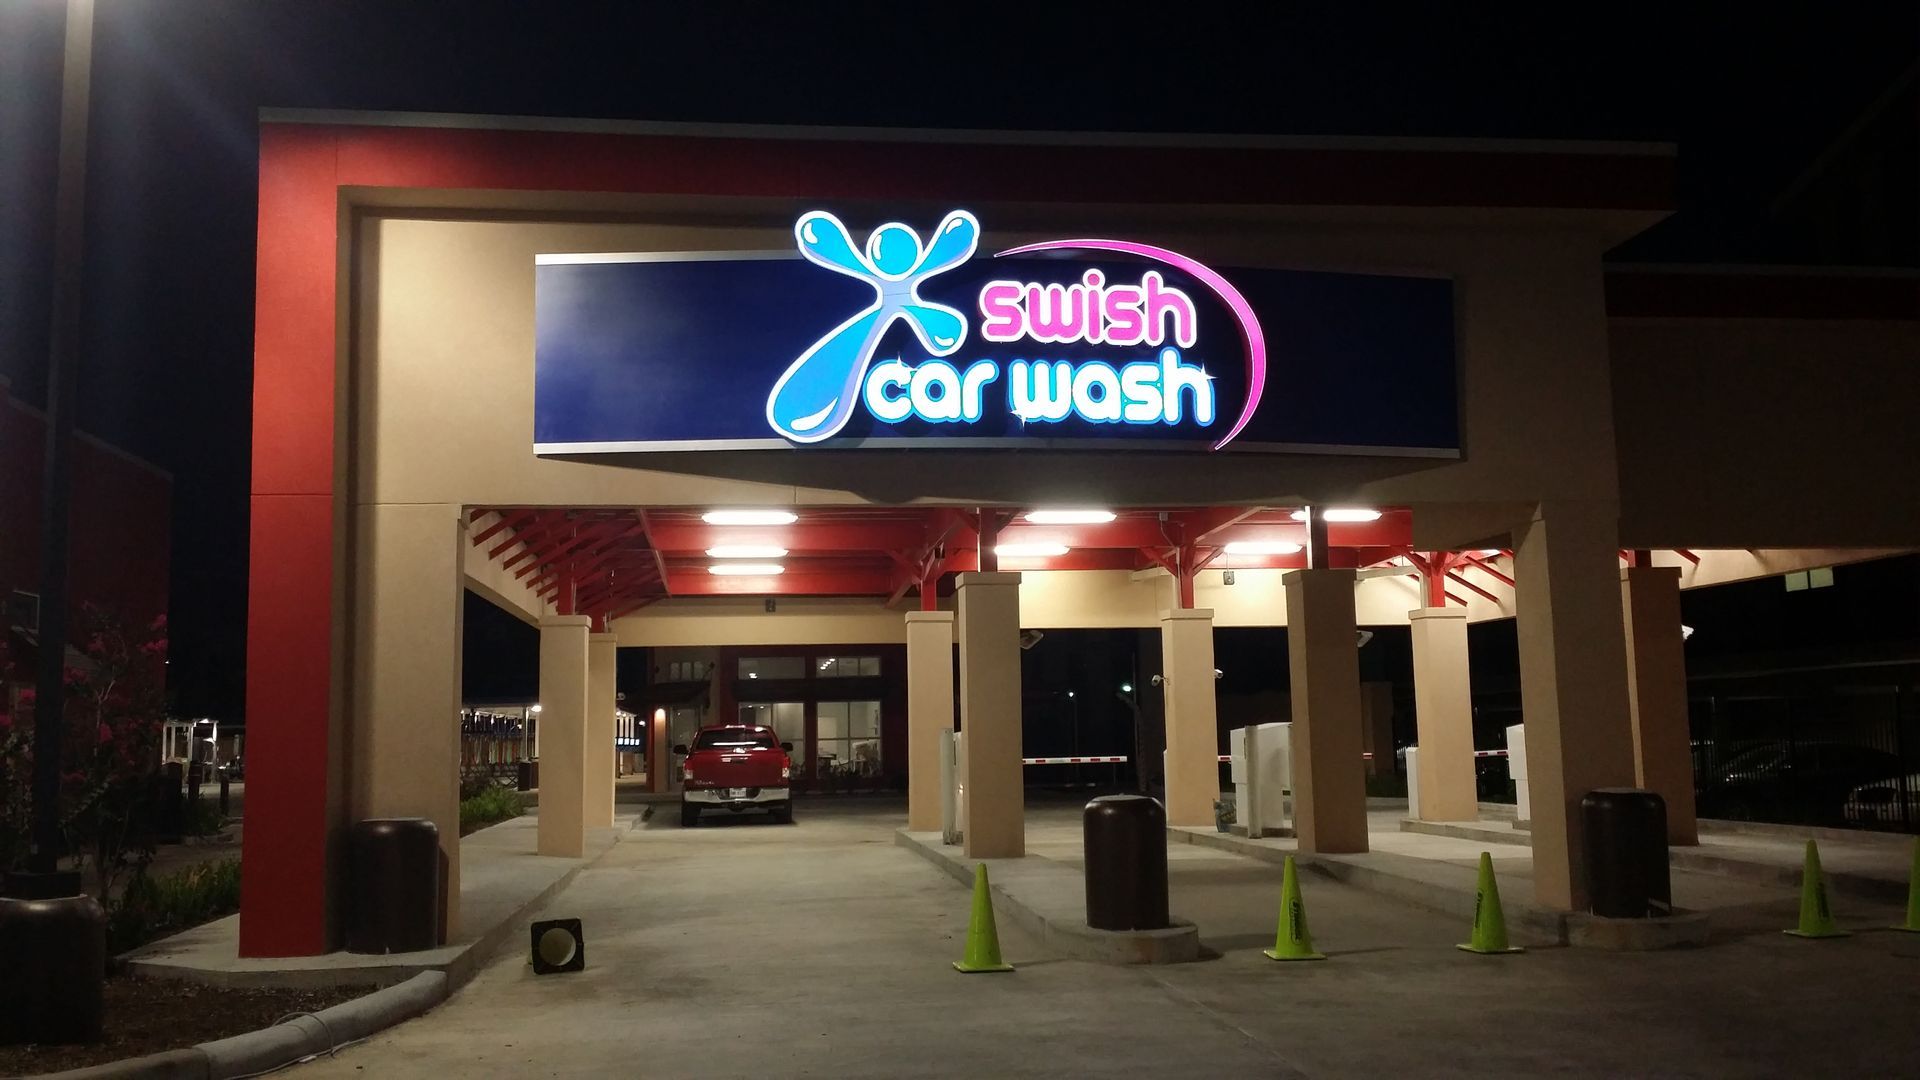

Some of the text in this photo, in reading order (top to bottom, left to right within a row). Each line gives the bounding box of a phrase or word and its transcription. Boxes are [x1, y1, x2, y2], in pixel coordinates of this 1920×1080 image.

[979, 268, 1197, 349] swish
[865, 346, 1216, 427] car wash
